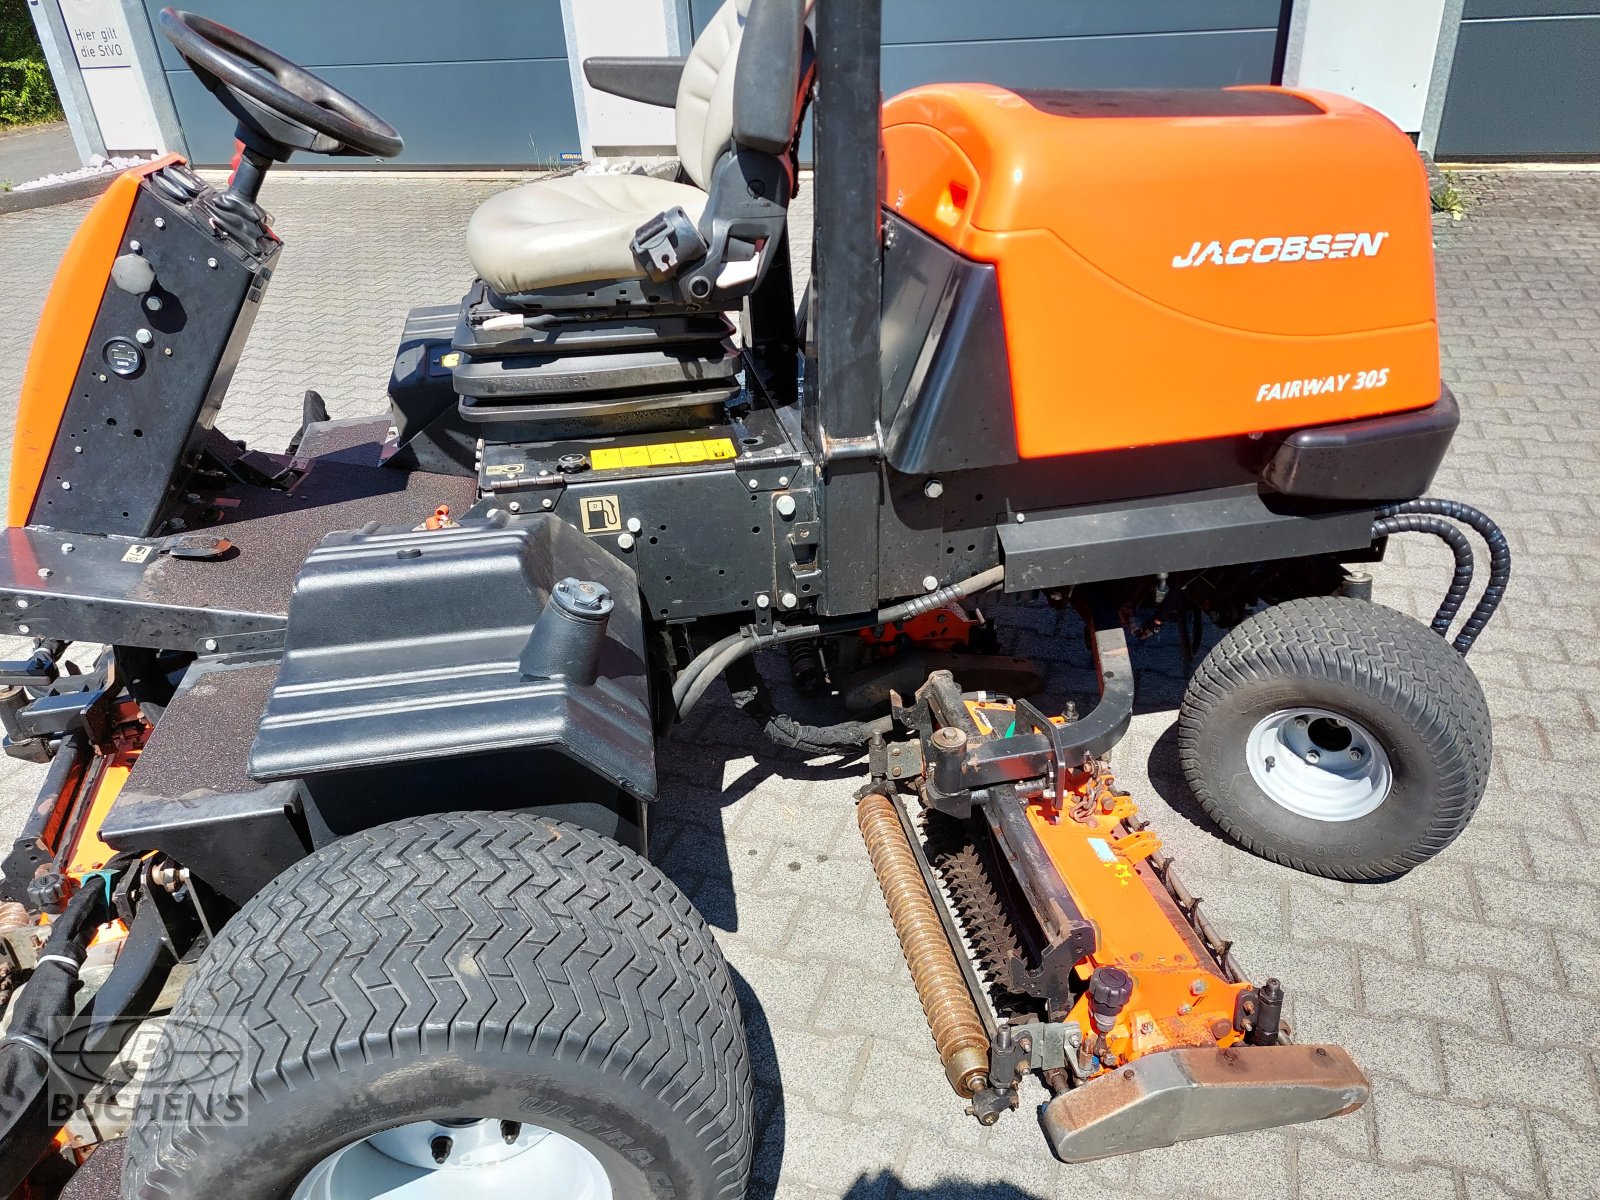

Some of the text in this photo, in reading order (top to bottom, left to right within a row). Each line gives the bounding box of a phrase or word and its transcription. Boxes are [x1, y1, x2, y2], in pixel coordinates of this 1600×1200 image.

[74, 26, 118, 43] Hier gilt
[80, 43, 123, 58] die StVO
[1172, 231, 1386, 268] JACOBSEN
[1256, 367, 1390, 402] FAIRWAY 305
